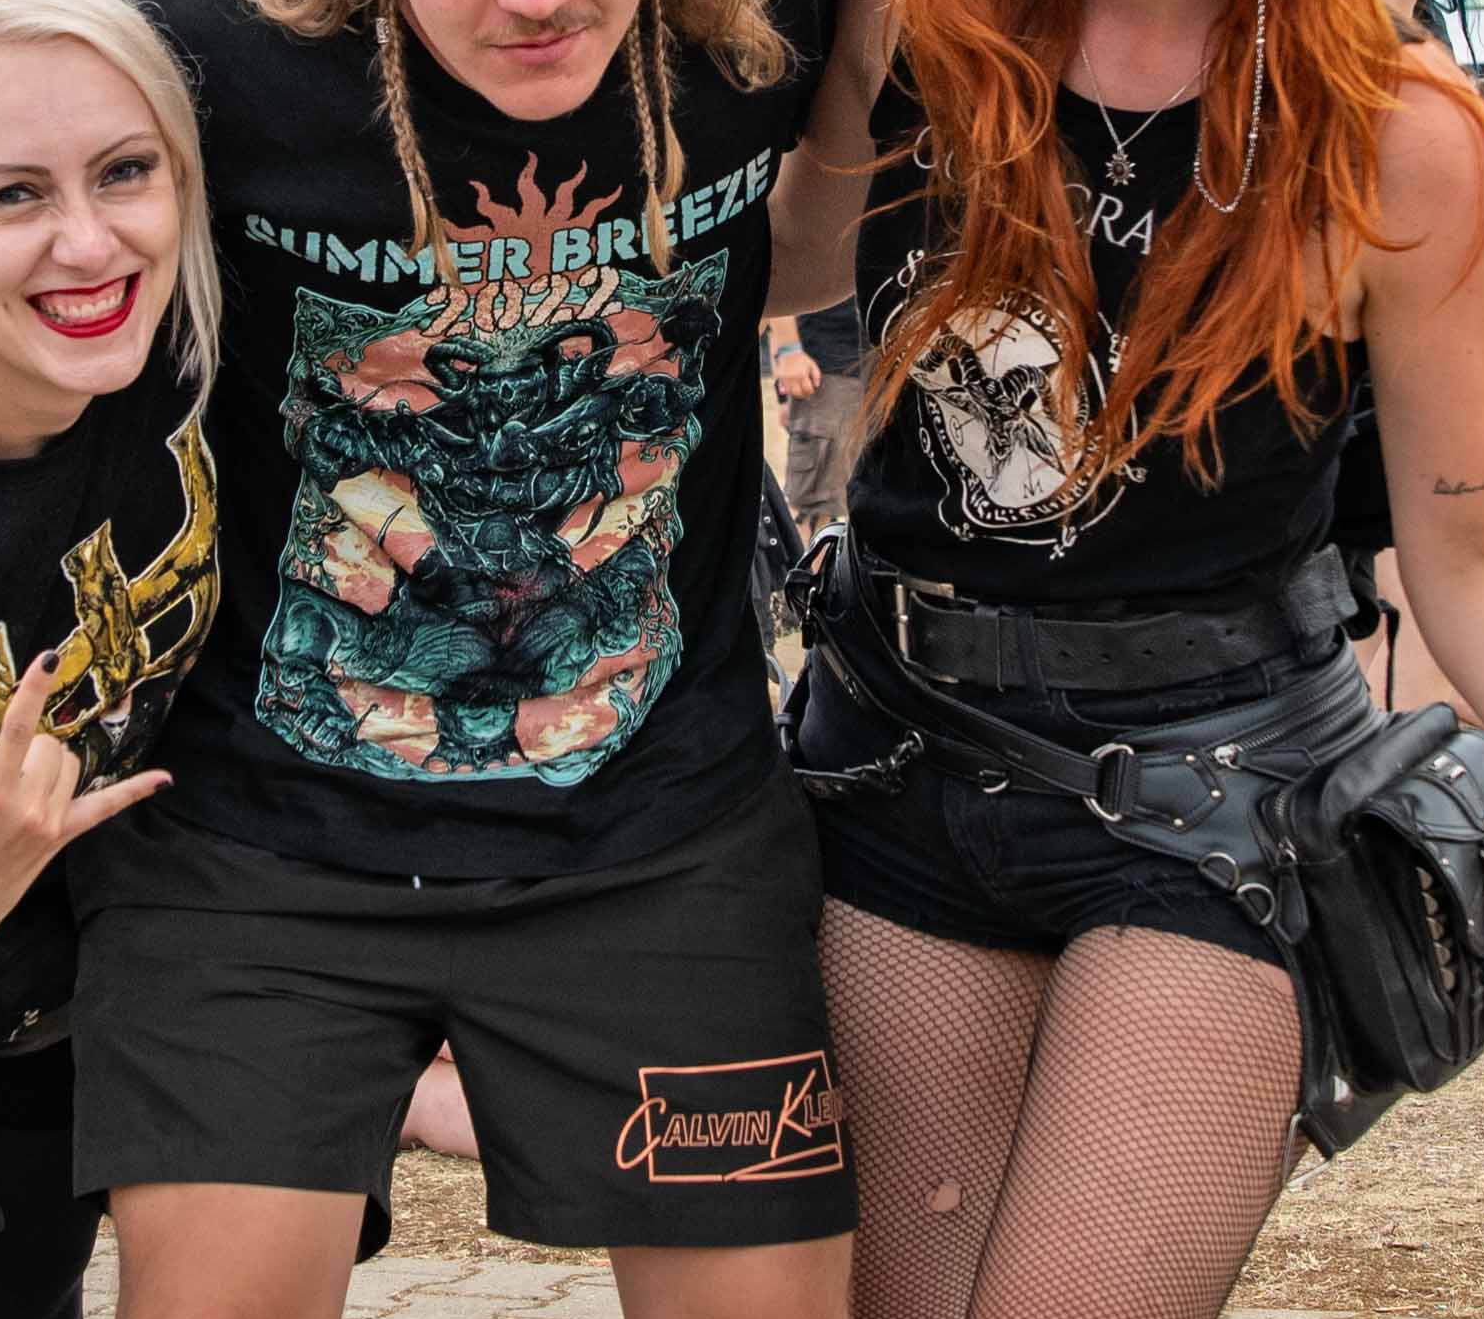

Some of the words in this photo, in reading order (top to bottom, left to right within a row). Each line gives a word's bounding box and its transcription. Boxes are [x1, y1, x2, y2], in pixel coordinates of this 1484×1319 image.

[243, 213, 533, 285] SUMMER
[551, 146, 773, 274] BREEZE
[425, 264, 625, 339] 2022
[616, 1096, 771, 1170] CALVIN
